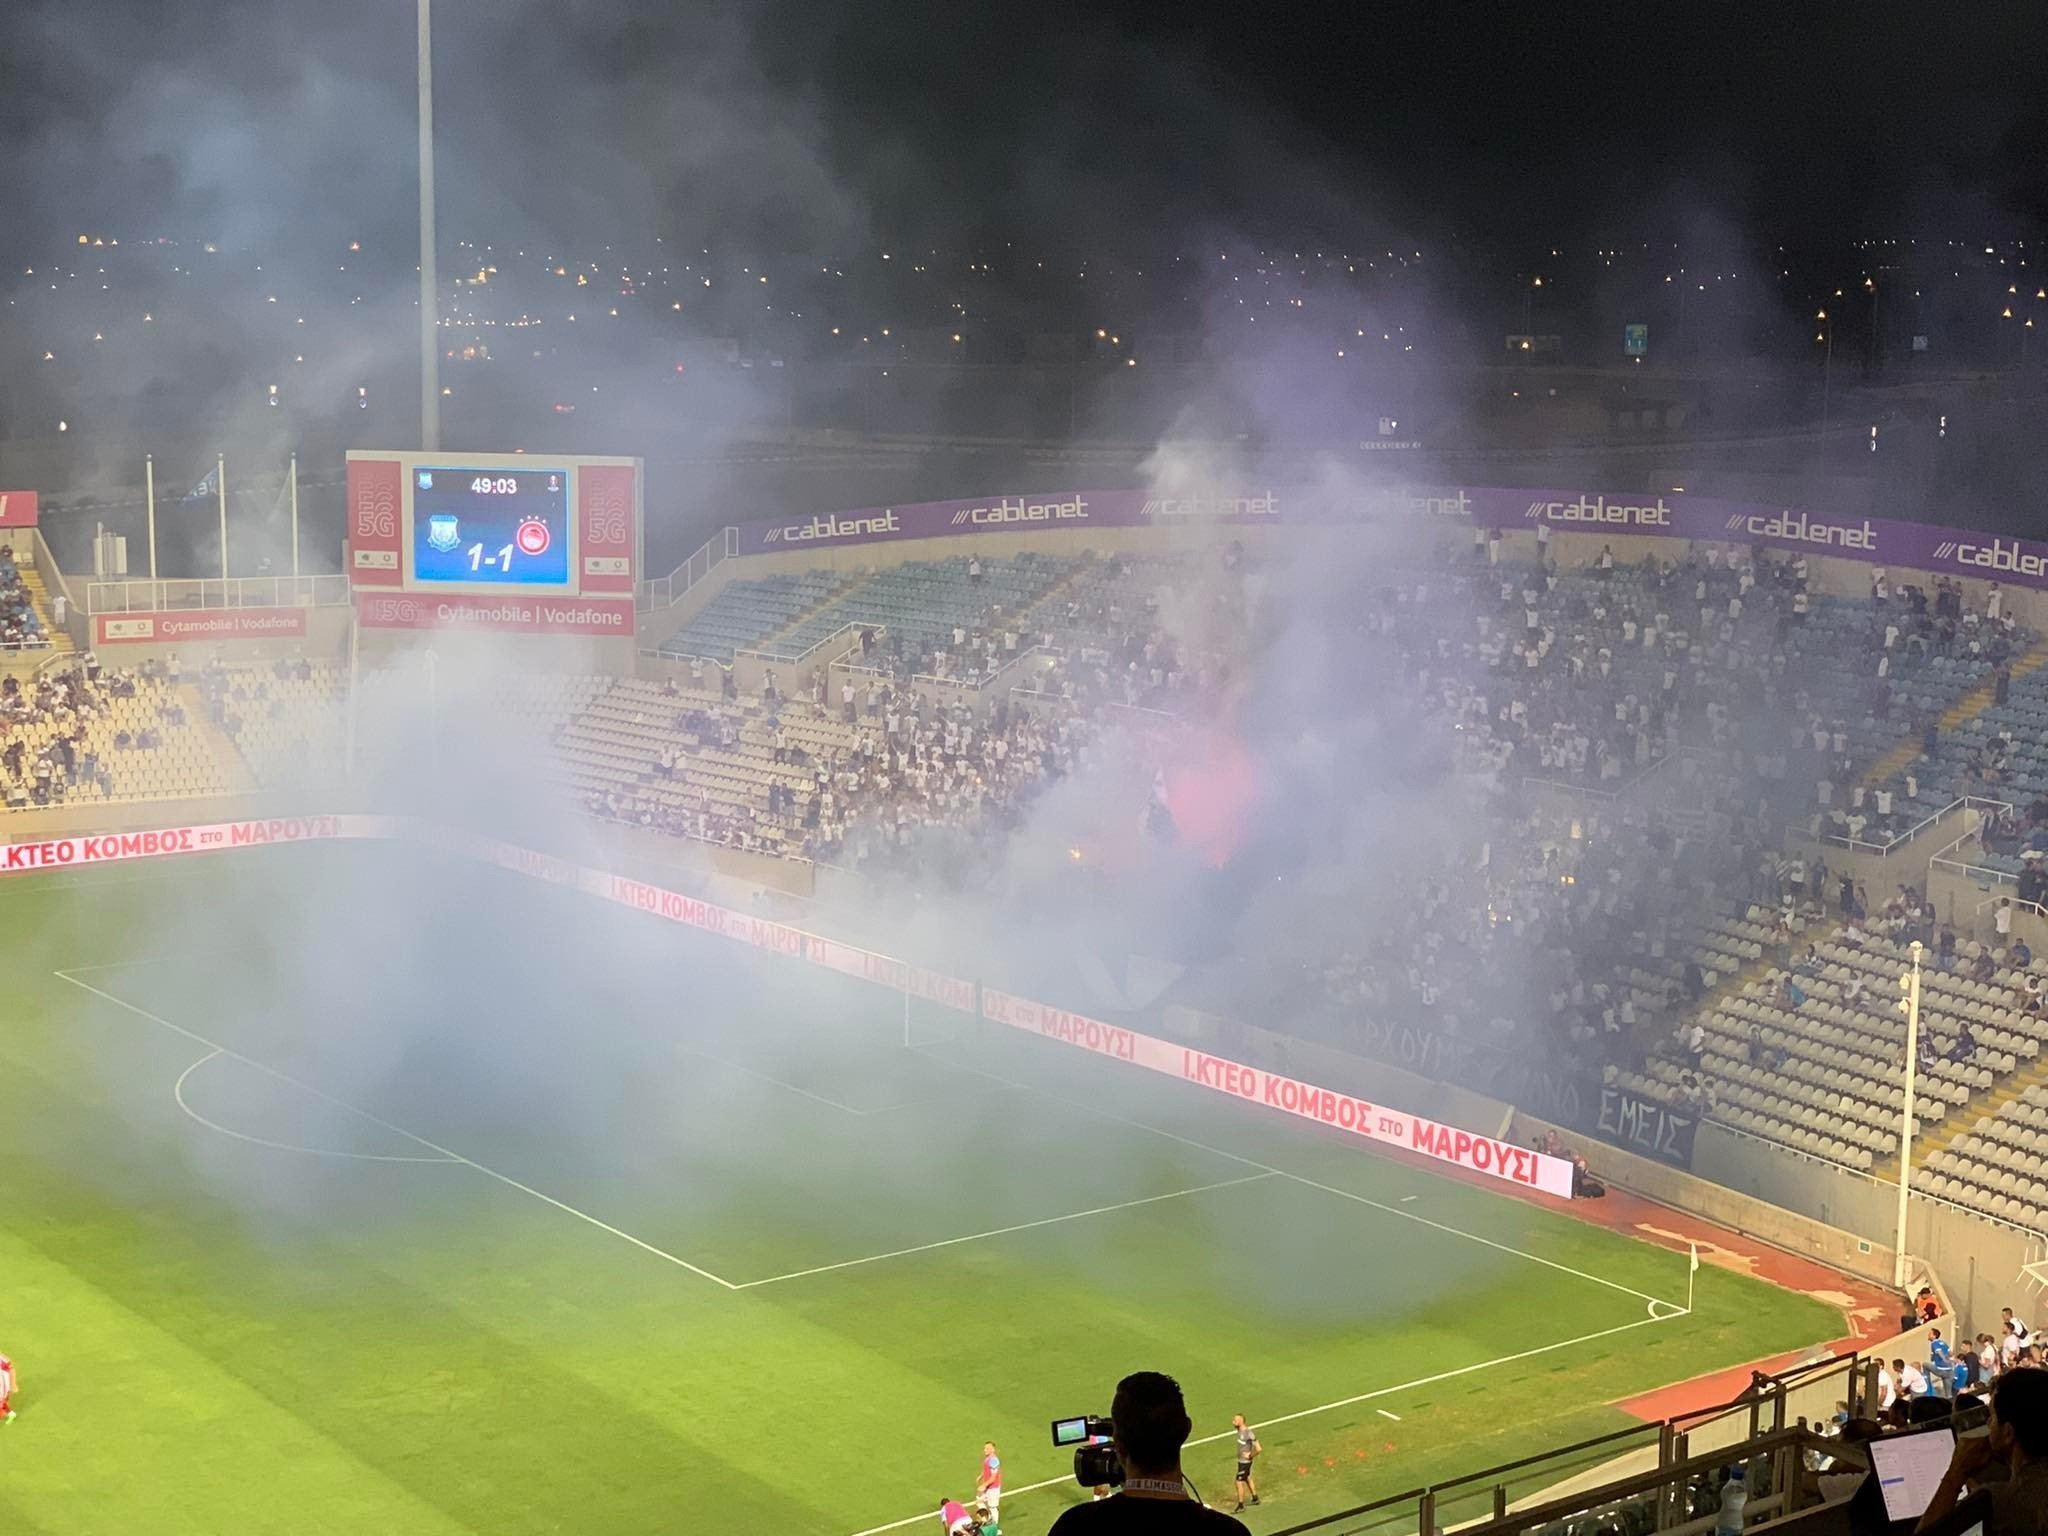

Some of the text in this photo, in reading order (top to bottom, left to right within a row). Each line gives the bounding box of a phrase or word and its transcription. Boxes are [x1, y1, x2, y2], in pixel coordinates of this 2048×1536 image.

[471, 477, 518, 495] 49:03
[972, 494, 1089, 524] cablenet
[1161, 490, 1279, 515] cablenet
[1547, 495, 1671, 526] cablenet
[358, 511, 395, 537] 5G
[783, 509, 900, 541] cablenet
[1747, 510, 1877, 550] cablenet
[467, 543, 514, 572] 1-1
[162, 615, 299, 635] Cytamobile Vodafone
[437, 604, 532, 623] Cytamobile
[544, 607, 623, 626] Vodafone
[84, 828, 194, 860] ΚΟΜΒΟΣ
[231, 815, 338, 845] ΜΑΡΟΥΣΙ
[661, 889, 727, 933] ΚΟΜΒΟΣ
[1040, 1007, 1136, 1061] ΜΑΡΟΥΣΙ
[1264, 1075, 1372, 1135] ΚΟΜΒΟΣ
[1412, 1119, 1539, 1185] ΜΑΡΟΥΣΙ
